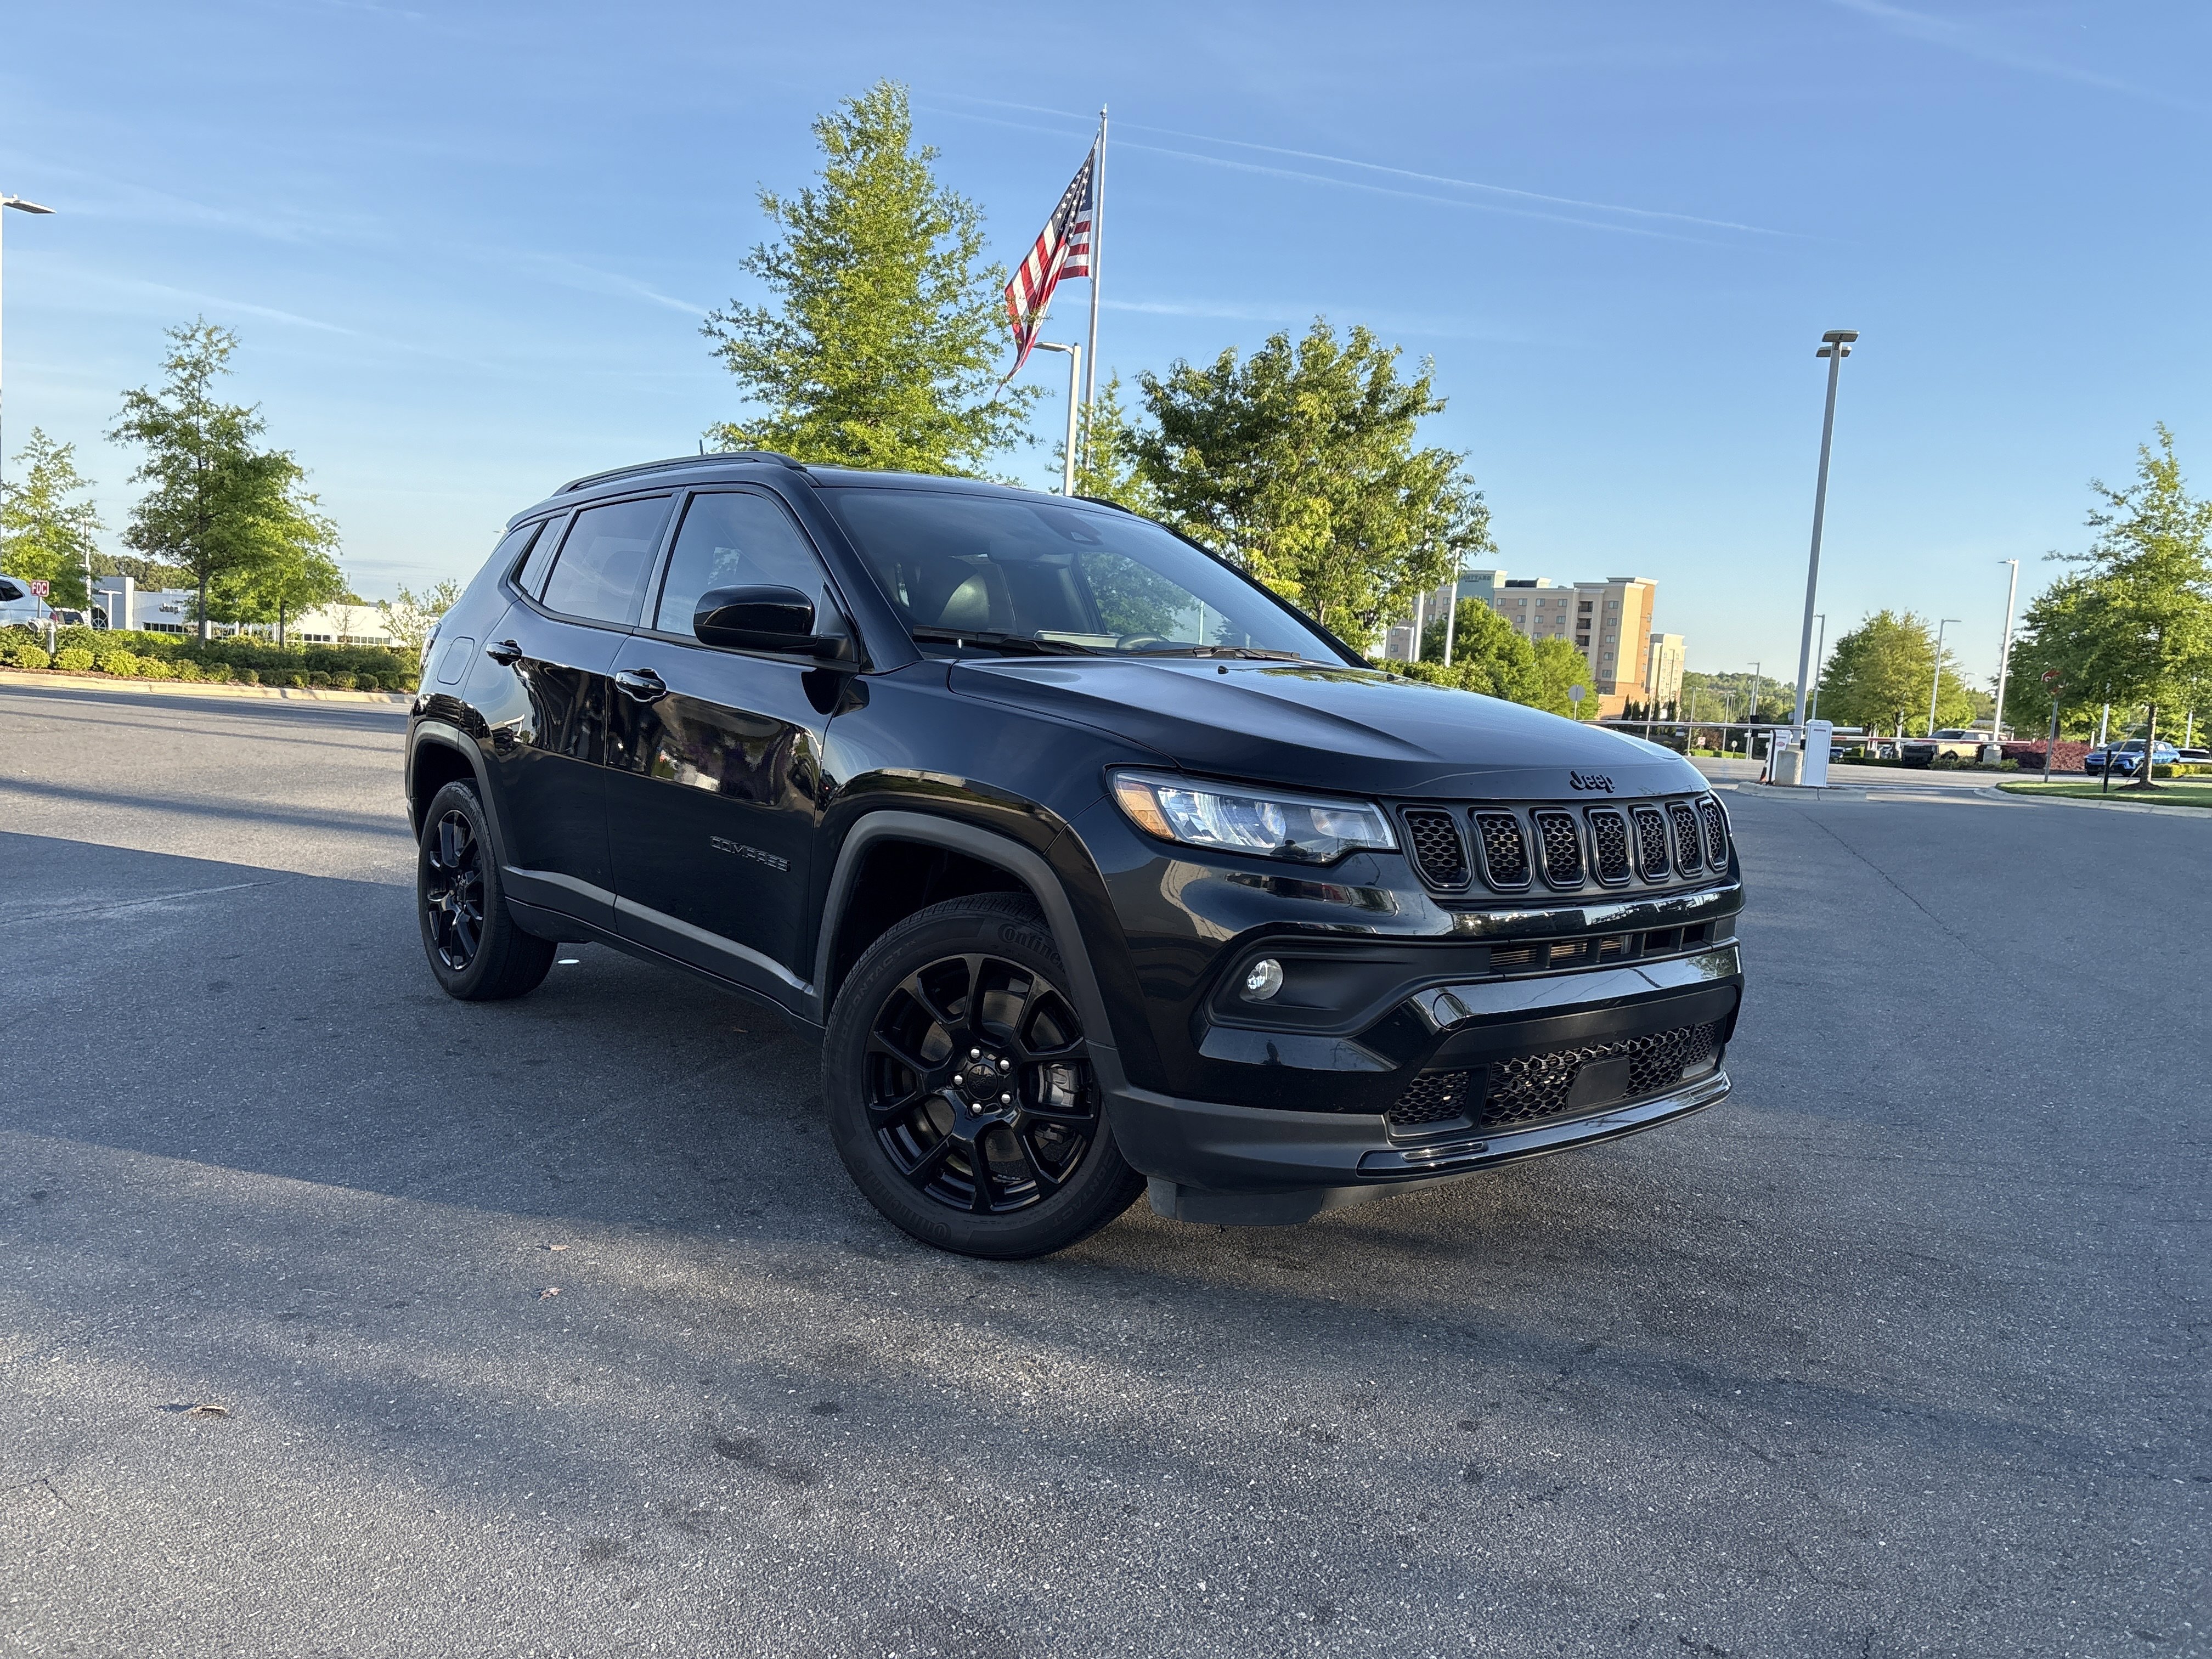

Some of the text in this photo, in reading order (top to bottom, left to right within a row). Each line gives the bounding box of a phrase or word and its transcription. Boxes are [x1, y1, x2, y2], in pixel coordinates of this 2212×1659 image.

[32, 582, 47, 594] FDC
[1570, 770, 1616, 794] Jeep
[710, 836, 791, 872] COMPASS
[997, 923, 1065, 974] Contine
